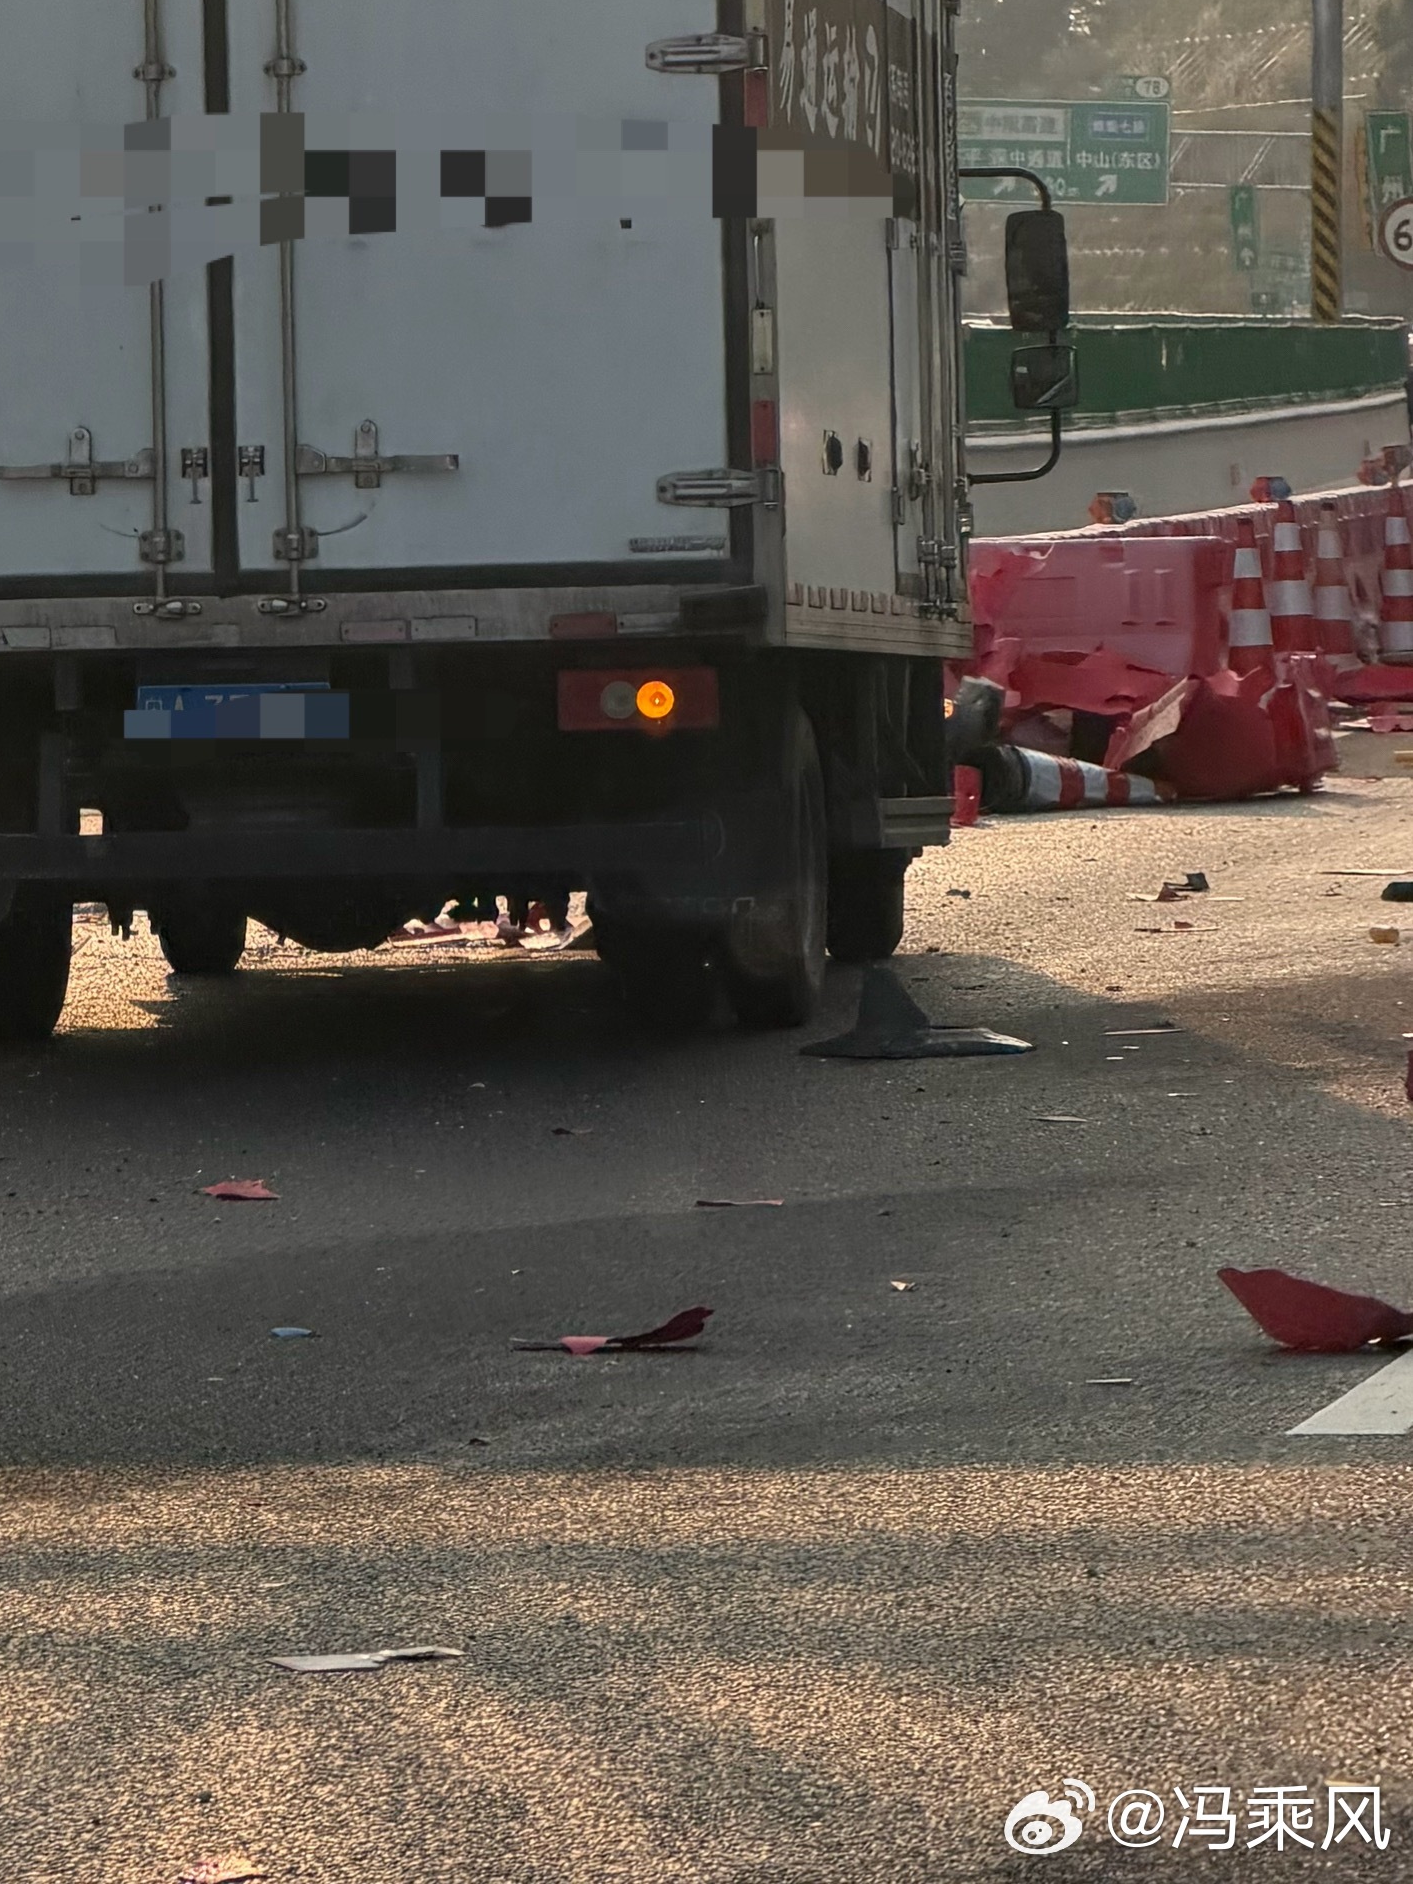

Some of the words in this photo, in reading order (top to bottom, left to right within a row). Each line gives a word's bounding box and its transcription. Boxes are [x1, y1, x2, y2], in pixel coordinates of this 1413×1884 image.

[1143, 79, 1162, 96] 78
[1076, 150, 1161, 170] 中山(东区)
